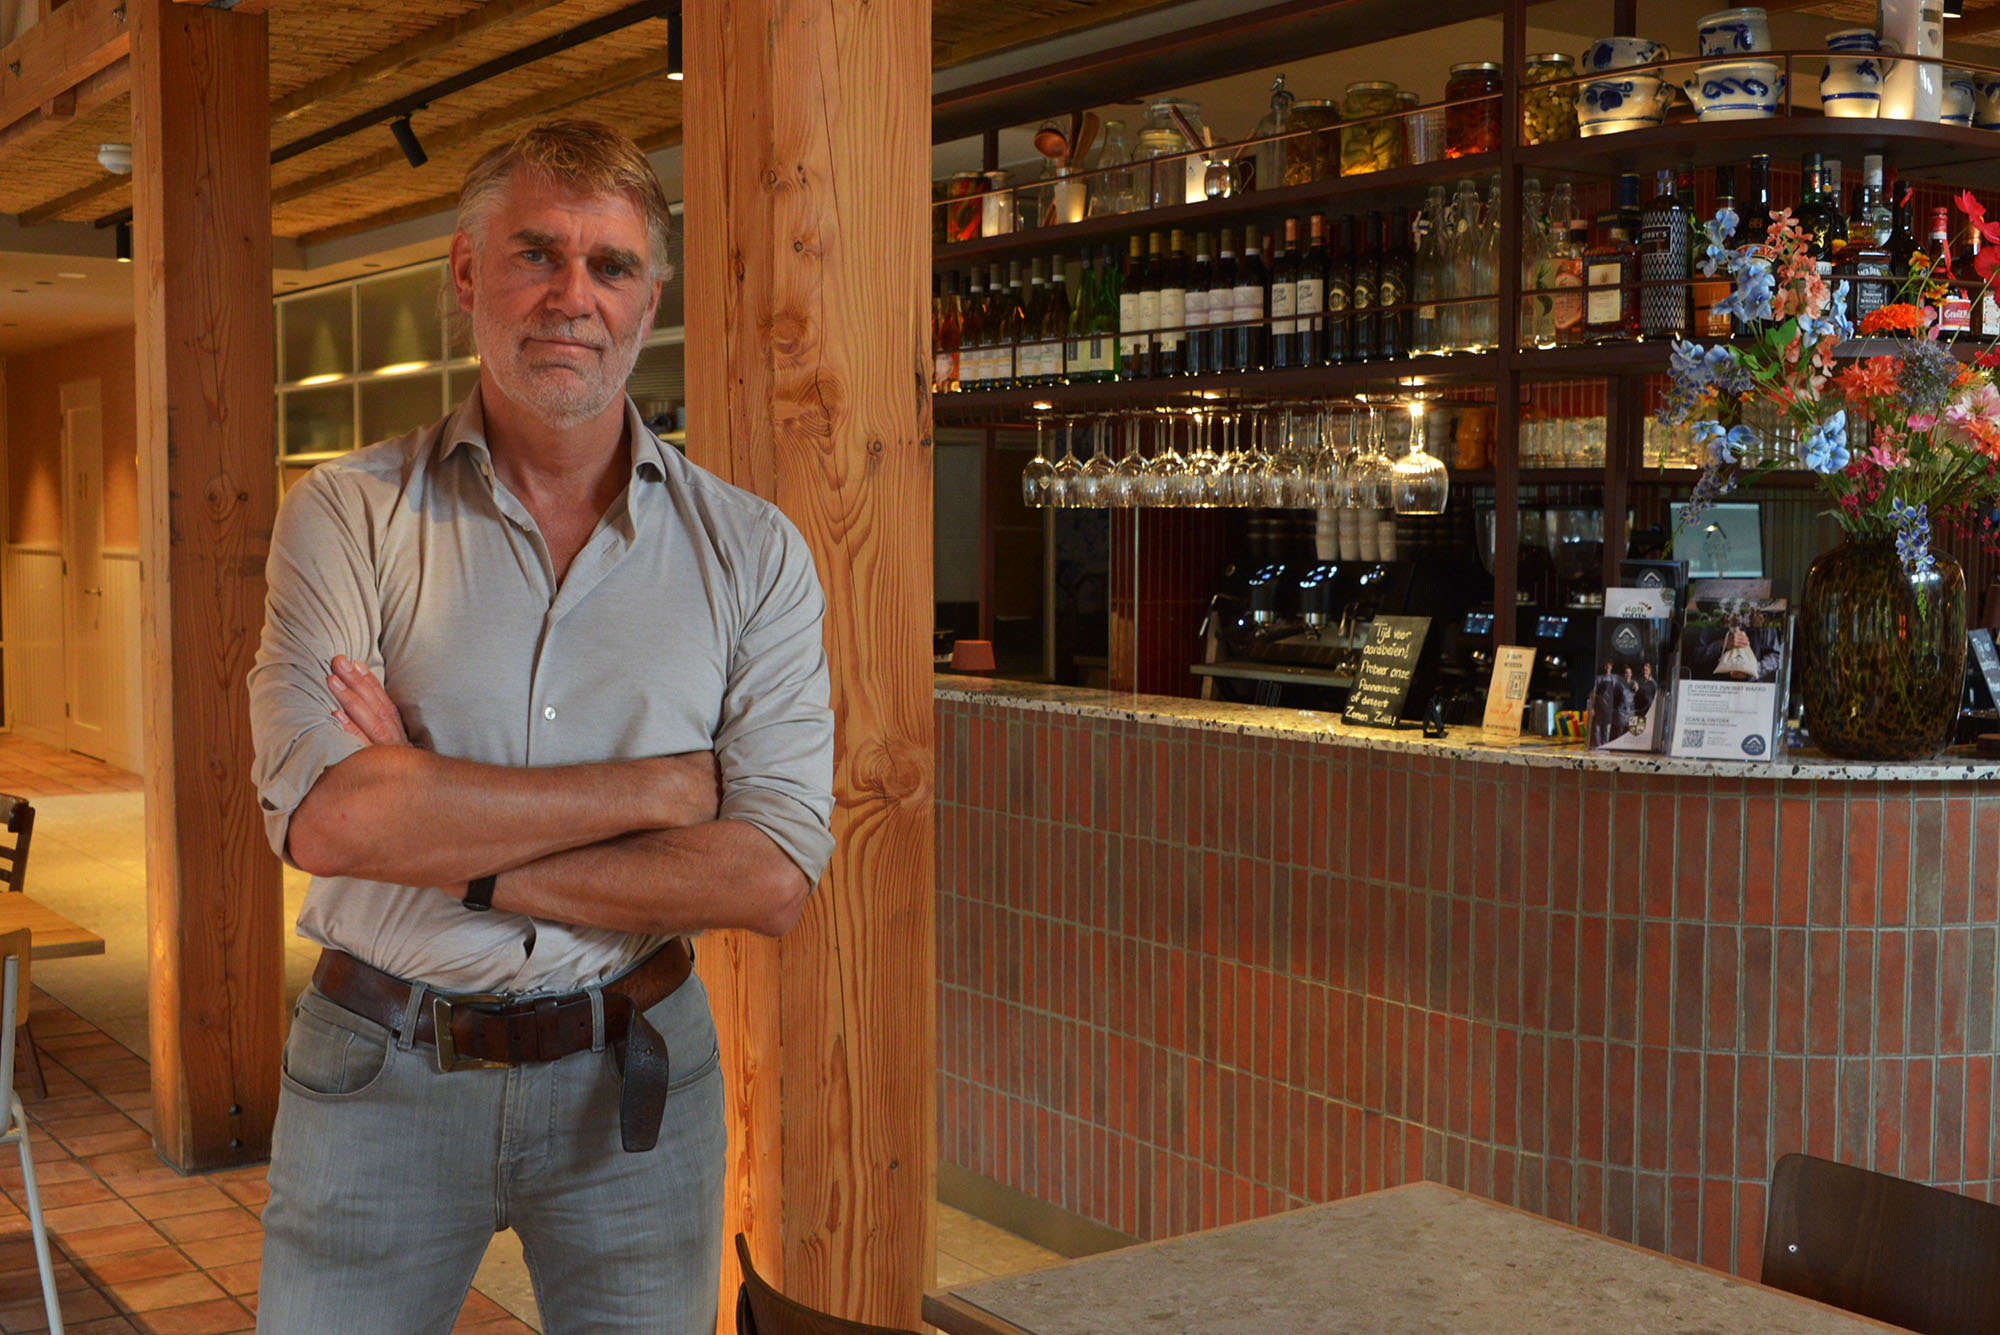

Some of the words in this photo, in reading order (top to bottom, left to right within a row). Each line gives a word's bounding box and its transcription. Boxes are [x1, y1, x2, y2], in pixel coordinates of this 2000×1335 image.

[1373, 622, 1392, 644] Tijd
[1394, 630, 1412, 640] voor
[1363, 642, 1410, 659] aardbeien!
[1390, 667, 1410, 679] onze
[1350, 691, 1362, 702] of
